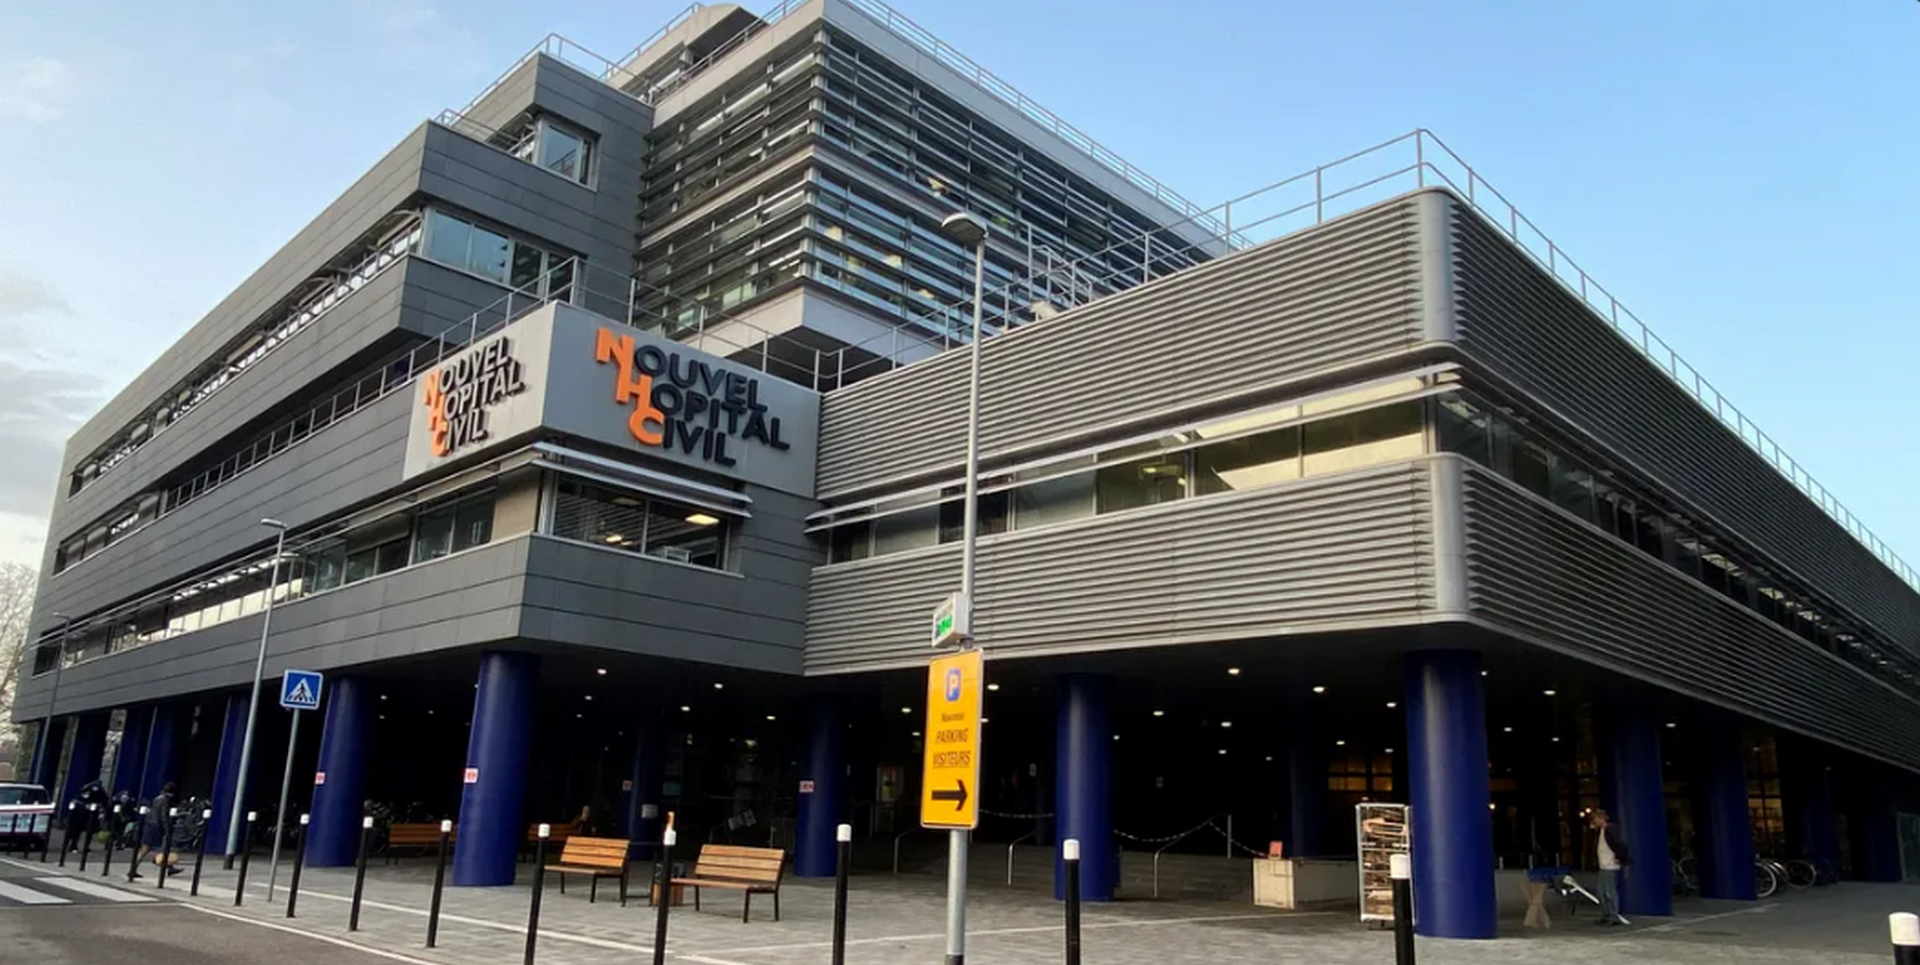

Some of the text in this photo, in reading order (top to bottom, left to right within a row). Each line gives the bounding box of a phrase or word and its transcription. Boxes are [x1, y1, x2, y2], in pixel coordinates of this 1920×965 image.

[424, 337, 509, 406] NOUVEL
[429, 360, 525, 431] HOPITAL
[596, 326, 767, 412] NOUVEL
[430, 408, 489, 457] CIVIL
[616, 374, 790, 451] HOPITAL
[629, 407, 736, 466] CIVIL
[933, 750, 971, 766] VISITEURS
[935, 728, 969, 744] PARKING
